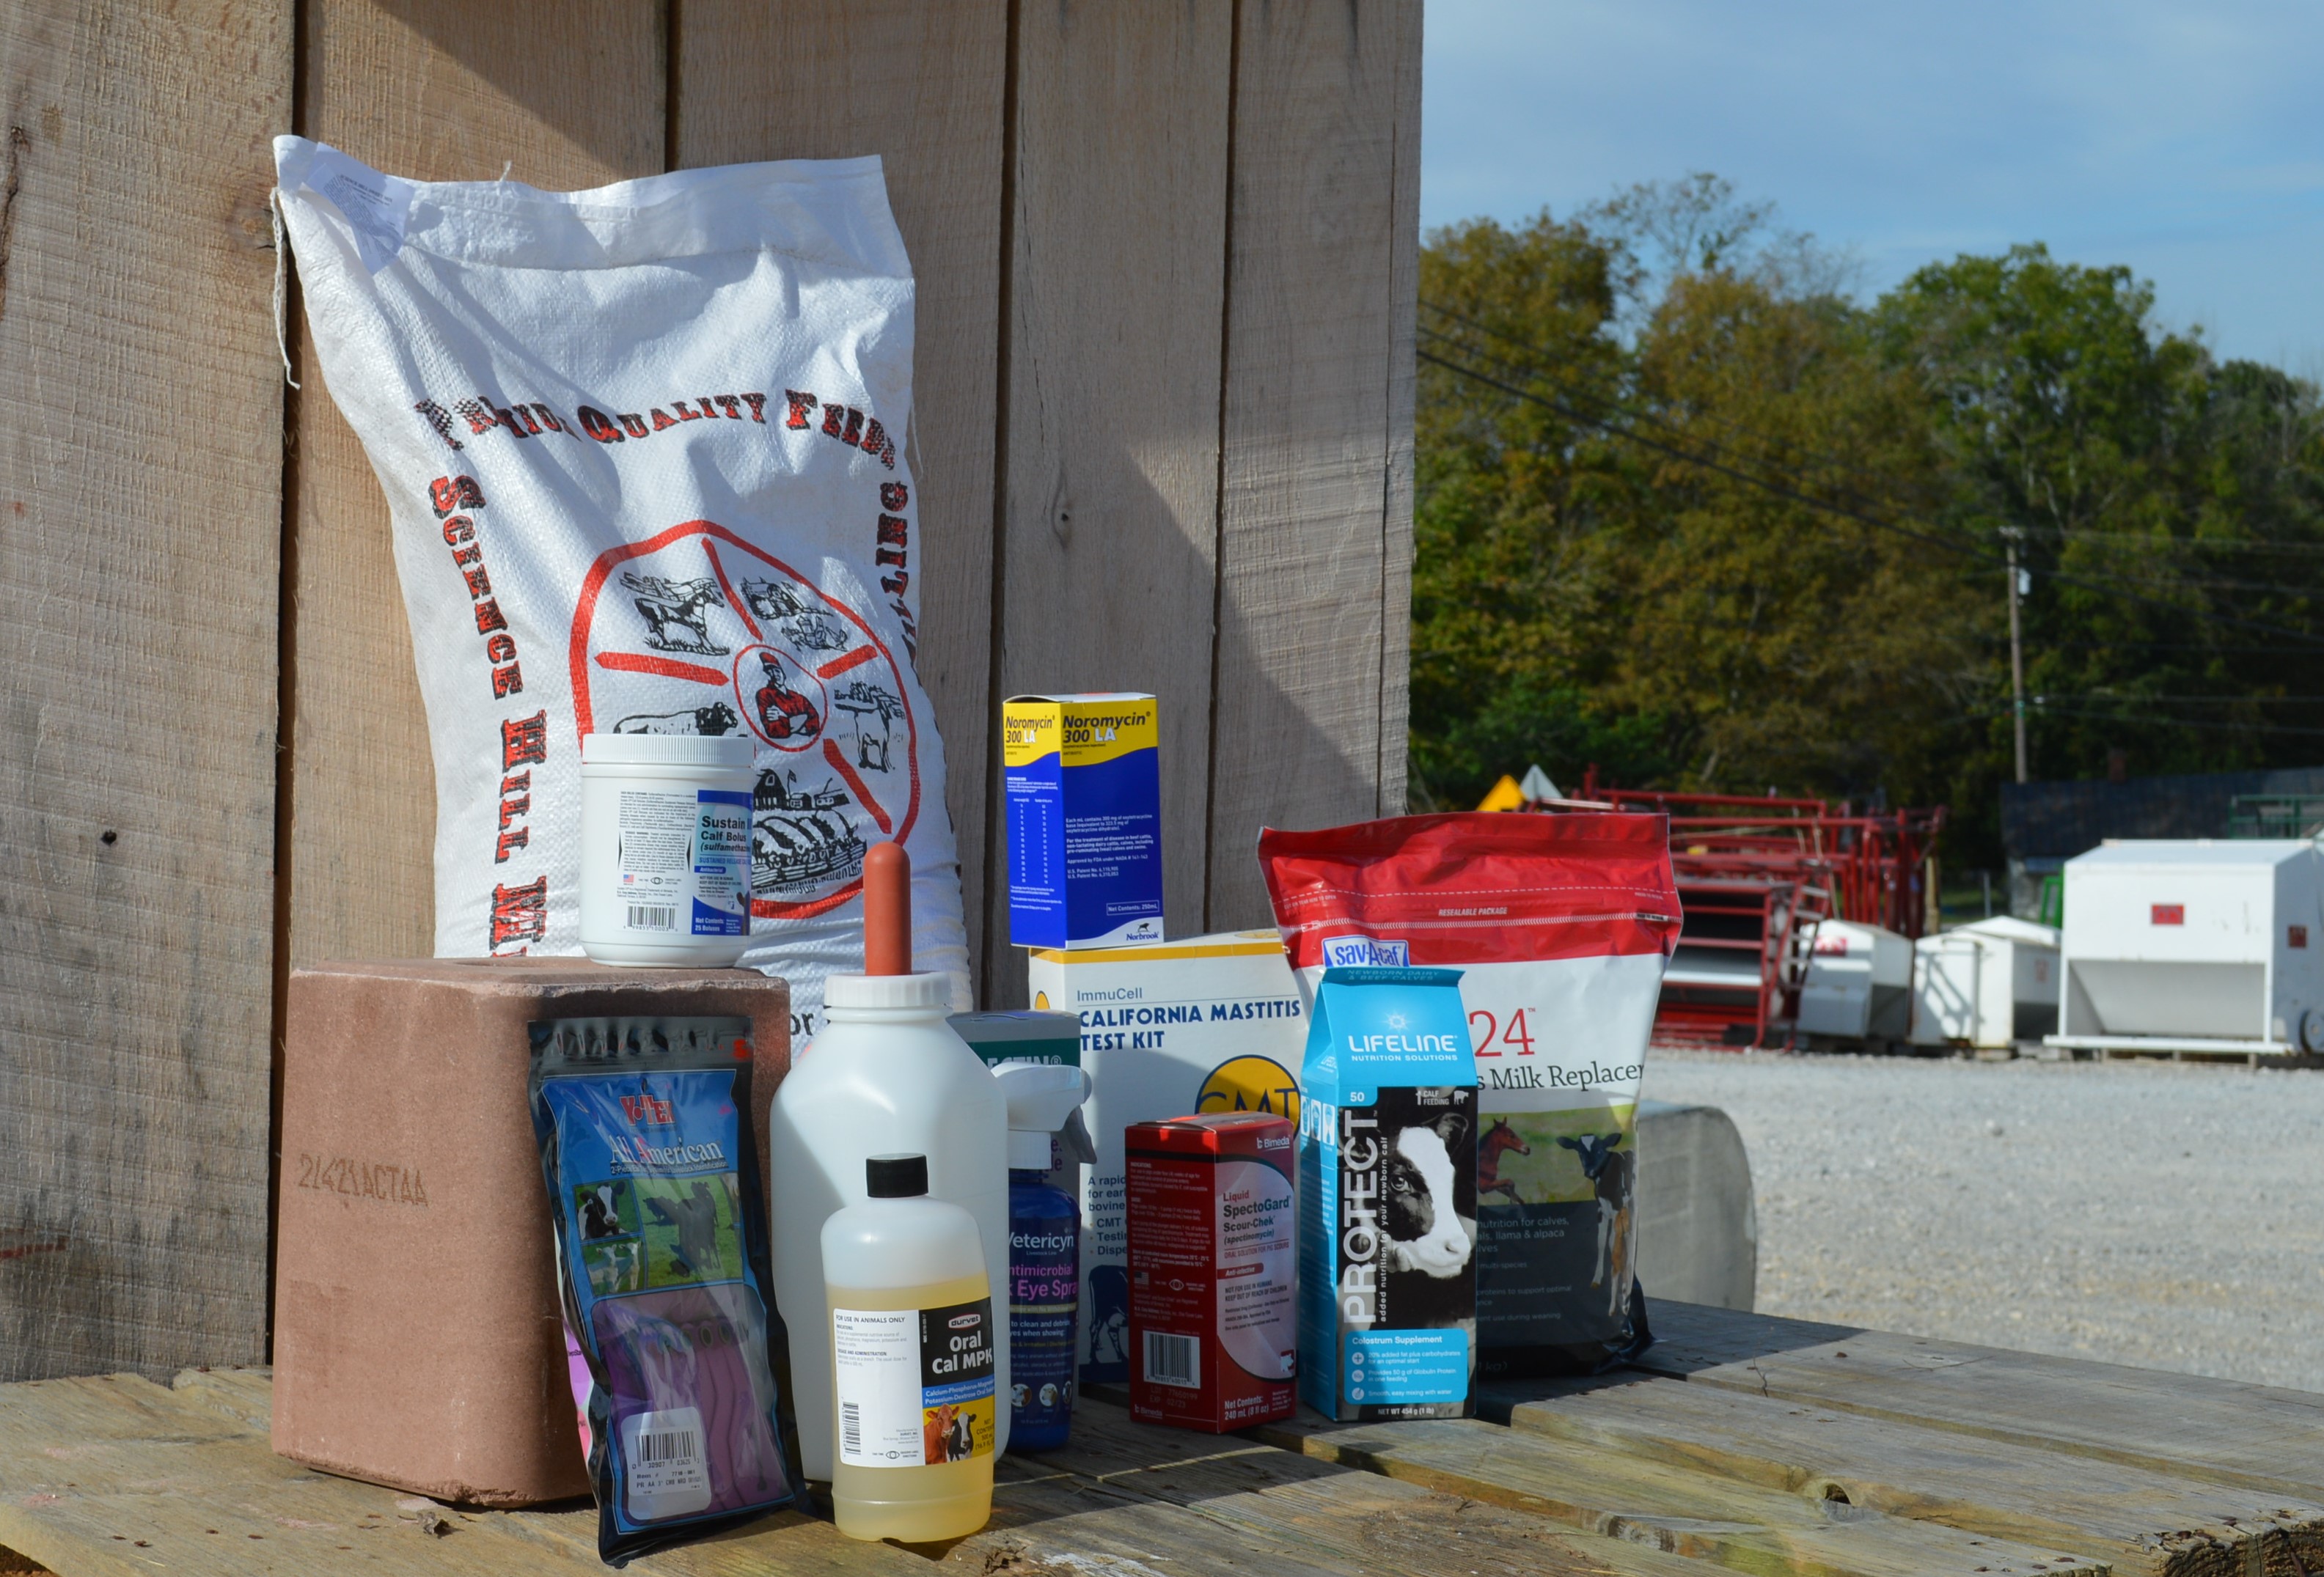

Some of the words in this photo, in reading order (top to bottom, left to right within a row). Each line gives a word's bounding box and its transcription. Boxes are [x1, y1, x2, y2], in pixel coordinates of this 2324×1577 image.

[577, 392, 767, 444] QUALITY
[428, 474, 523, 699] SCIENCE
[494, 709, 547, 864] HILL
[1005, 730, 1022, 743] 300
[1024, 729, 1036, 743] LA
[1063, 729, 1090, 743] 300
[1094, 727, 1117, 742] LA
[702, 815, 746, 830] Sustain
[700, 831, 723, 841] Calf
[726, 832, 747, 842] Bolus
[699, 856, 726, 864] SUSTAINED
[1438, 908, 1477, 917] RESEALABLE
[1478, 906, 1508, 916] PACKAGE
[1077, 987, 1143, 1002] ImmuCell
[1080, 1005, 1203, 1028] CALIFORNIA
[1209, 999, 1301, 1021] MASTITIS
[1081, 1032, 1124, 1051] TEST
[1133, 1031, 1165, 1049] KIT
[1348, 1034, 1457, 1052] LIFELINE
[1489, 1065, 1544, 1090] Milk
[1547, 1061, 1645, 1092] Replacer
[1349, 1092, 1365, 1103] 50
[1423, 1089, 1439, 1098] CALF
[1423, 1098, 1450, 1106] FEEDING
[1264, 1137, 1290, 1149] Bimeda
[1380, 1136, 1388, 1155] calf
[634, 1137, 724, 1165] American
[1088, 1177, 1096, 1185] A
[1088, 1189, 1104, 1199] for
[1107, 1188, 1126, 1198] earl
[1223, 1190, 1250, 1203] Liquid
[1088, 1200, 1126, 1212] bovine
[1223, 1196, 1290, 1219] SpectoGard
[1096, 1217, 1121, 1228] CMT
[1381, 1205, 1389, 1226] your
[1521, 1217, 1535, 1227] for
[1223, 1216, 1275, 1232] Scour-Chek
[1097, 1232, 1127, 1242] Testi
[1224, 1229, 1275, 1246] (spectinomycin)
[1379, 1229, 1388, 1243] for
[1496, 1231, 1522, 1240] llama
[1524, 1229, 1531, 1239] &
[1533, 1229, 1565, 1239] alpaca
[1098, 1245, 1127, 1257] Dispe
[1224, 1250, 1236, 1259] ORAL
[1237, 1248, 1258, 1258] SOLUTION
[1258, 1246, 1267, 1255] FOR
[1274, 1241, 1289, 1251] SCOURS
[1009, 1263, 1073, 1276] ntimicrobial
[1018, 1279, 1049, 1301] Eye
[1052, 1279, 1077, 1300] Spra
[1517, 1287, 1545, 1295] support
[1379, 1292, 1387, 1323] added
[950, 1315, 979, 1327] durvet
[950, 1330, 982, 1352] Oral
[1352, 1337, 1393, 1345] Colostrum
[1394, 1335, 1443, 1346] Supplement
[932, 1354, 958, 1374] Cal
[963, 1348, 993, 1370] MPK
[1225, 1399, 1236, 1409] Net
[1237, 1395, 1264, 1408] Contents:
[1225, 1408, 1236, 1420] 240
[1238, 1407, 1247, 1418] mL
[1426, 1406, 1434, 1415] lb)
